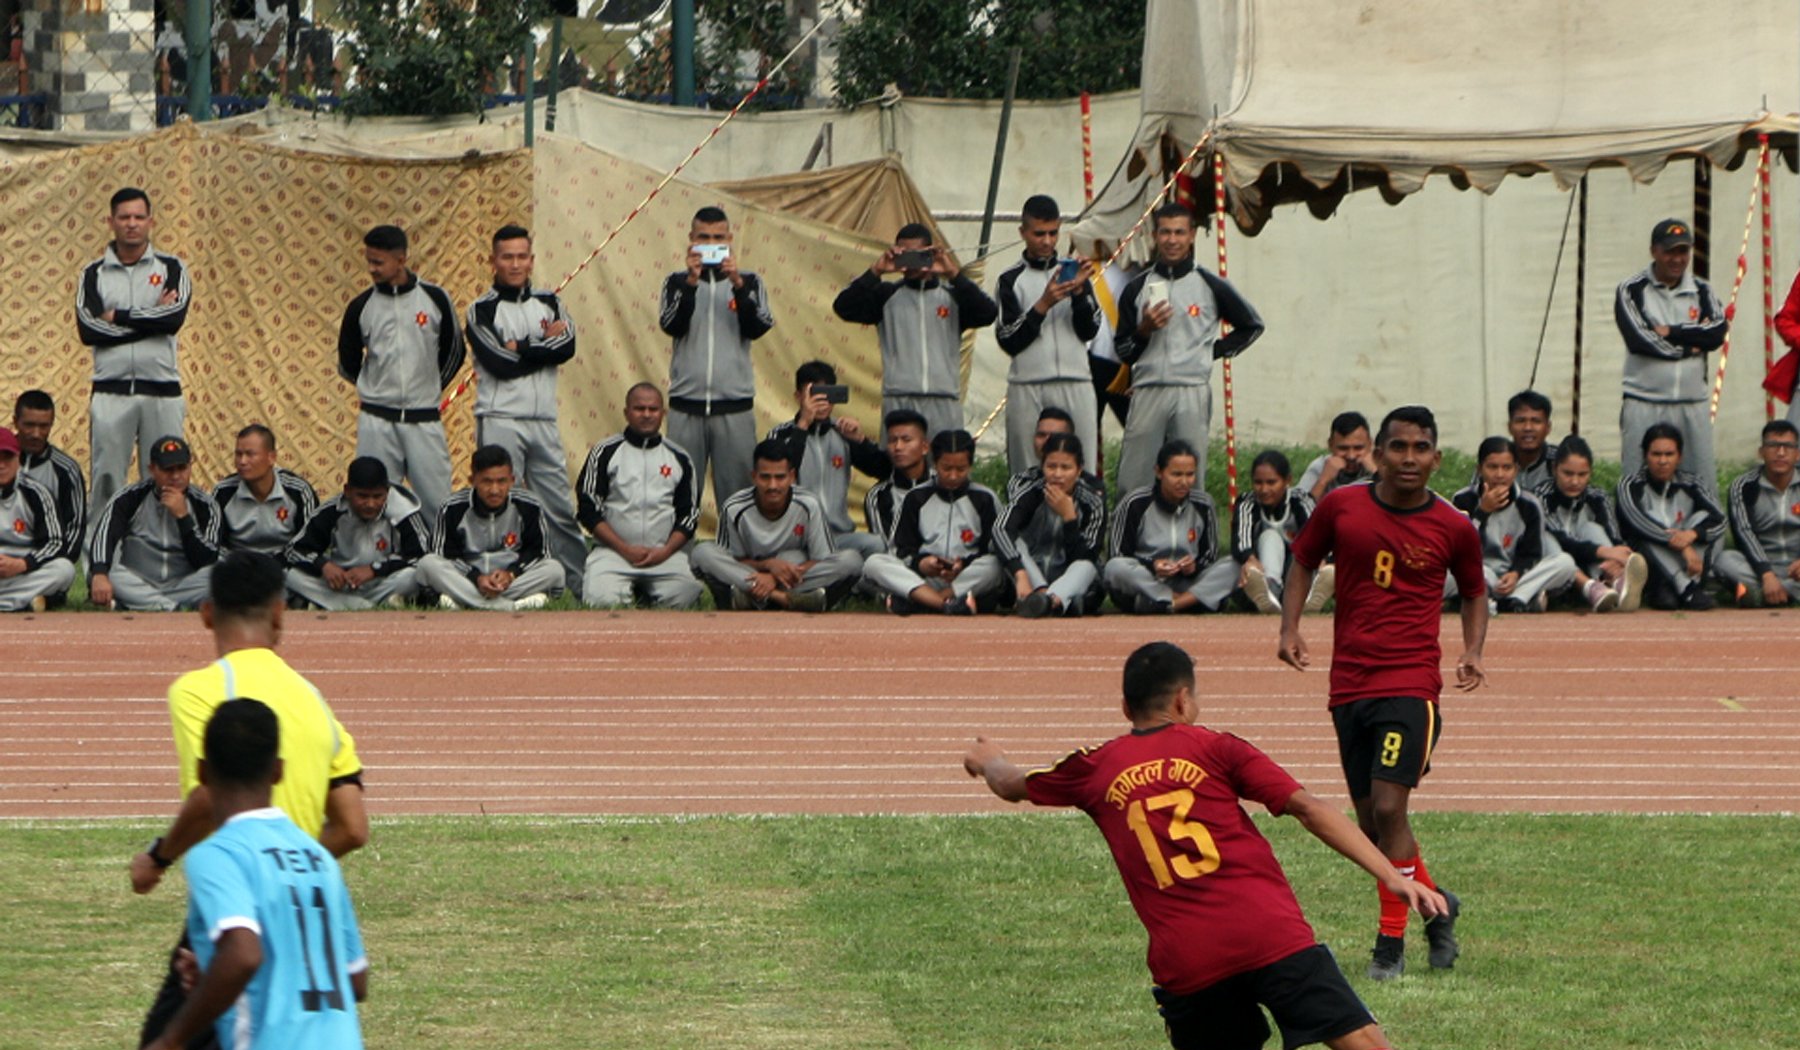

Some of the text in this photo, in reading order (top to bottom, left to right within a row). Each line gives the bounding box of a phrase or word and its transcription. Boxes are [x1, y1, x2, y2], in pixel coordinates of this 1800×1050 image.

[1374, 550, 1394, 589] 8
[1381, 732, 1402, 767] 8
[1127, 788, 1220, 890] 13
[288, 885, 345, 1012] 11
